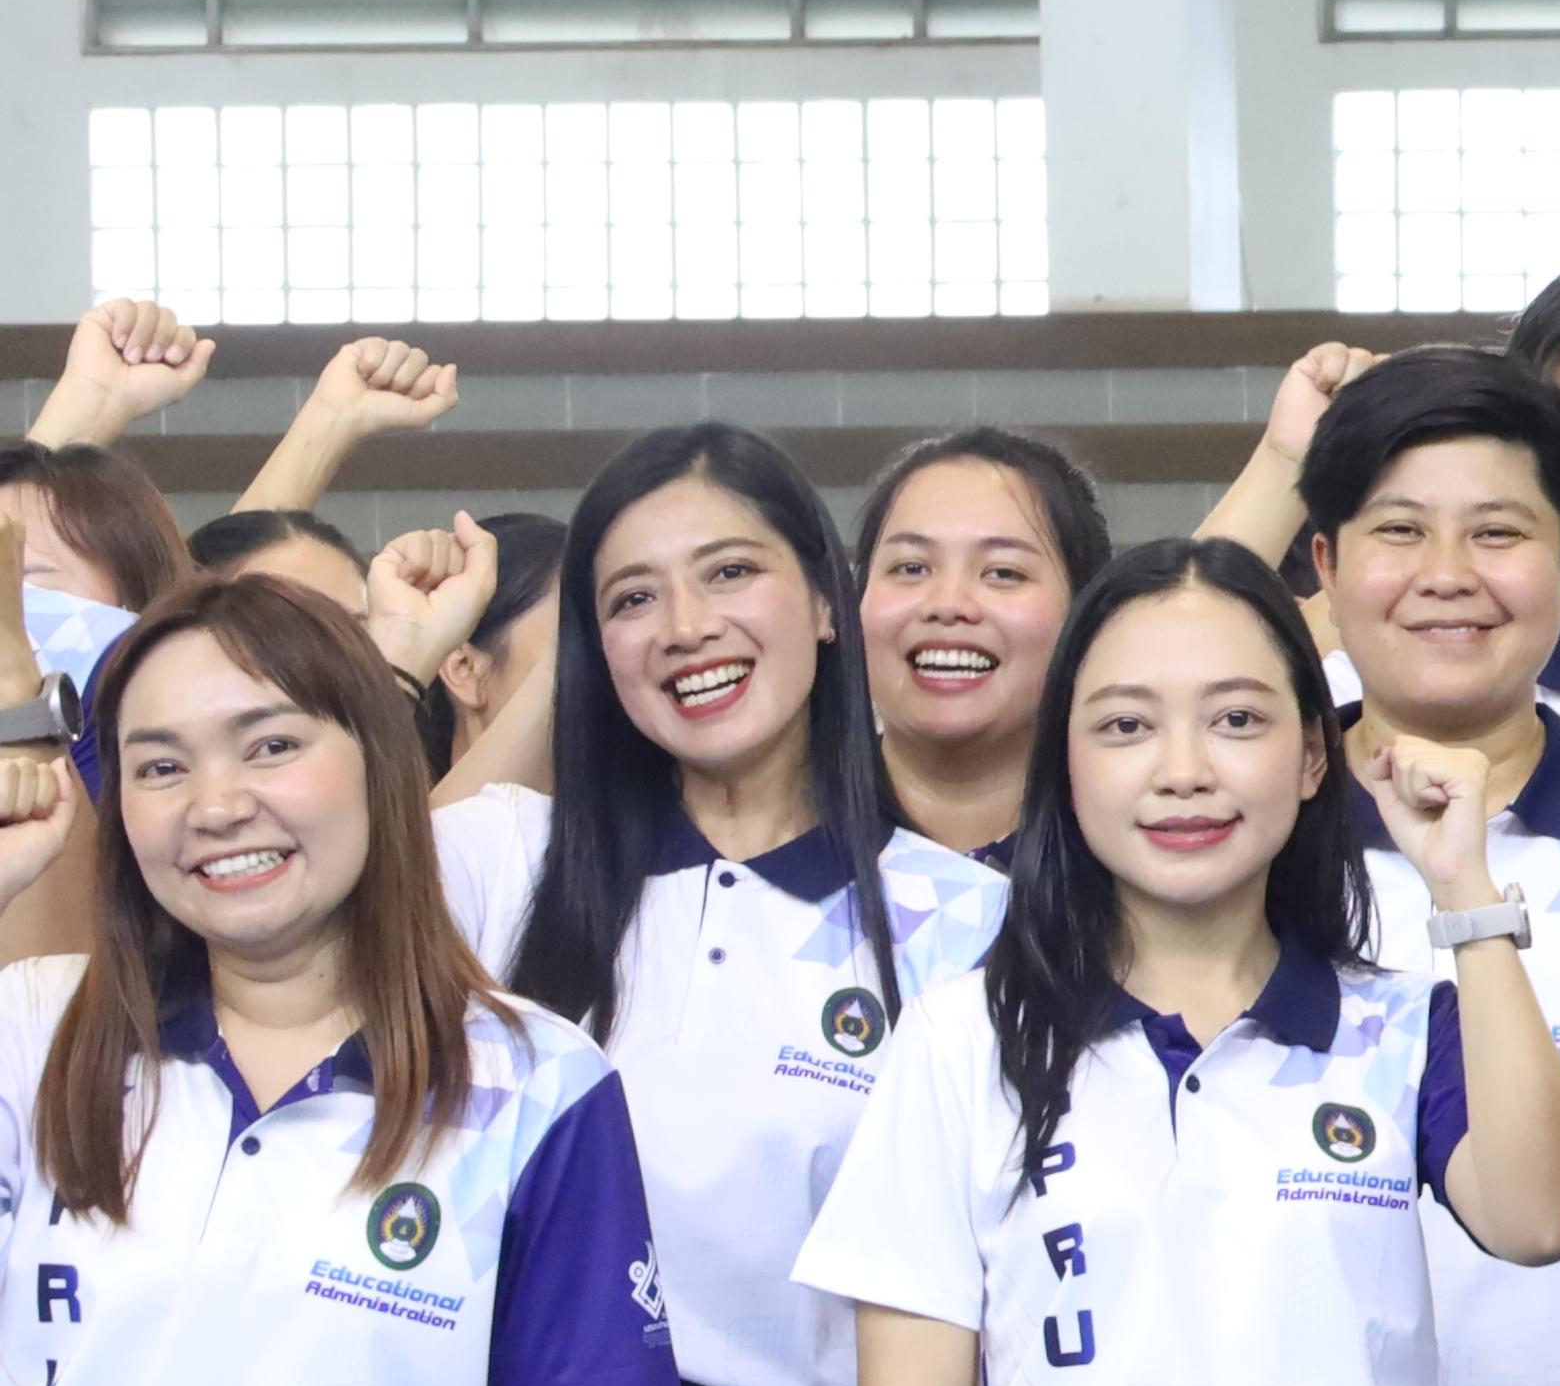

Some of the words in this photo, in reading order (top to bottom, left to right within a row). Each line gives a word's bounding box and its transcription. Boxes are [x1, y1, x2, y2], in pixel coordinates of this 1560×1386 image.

[1276, 1167, 1413, 1194] Educational
[1276, 1186, 1410, 1211] Administration
[310, 1258, 466, 1313] Educational
[305, 1280, 457, 1332] Administration
